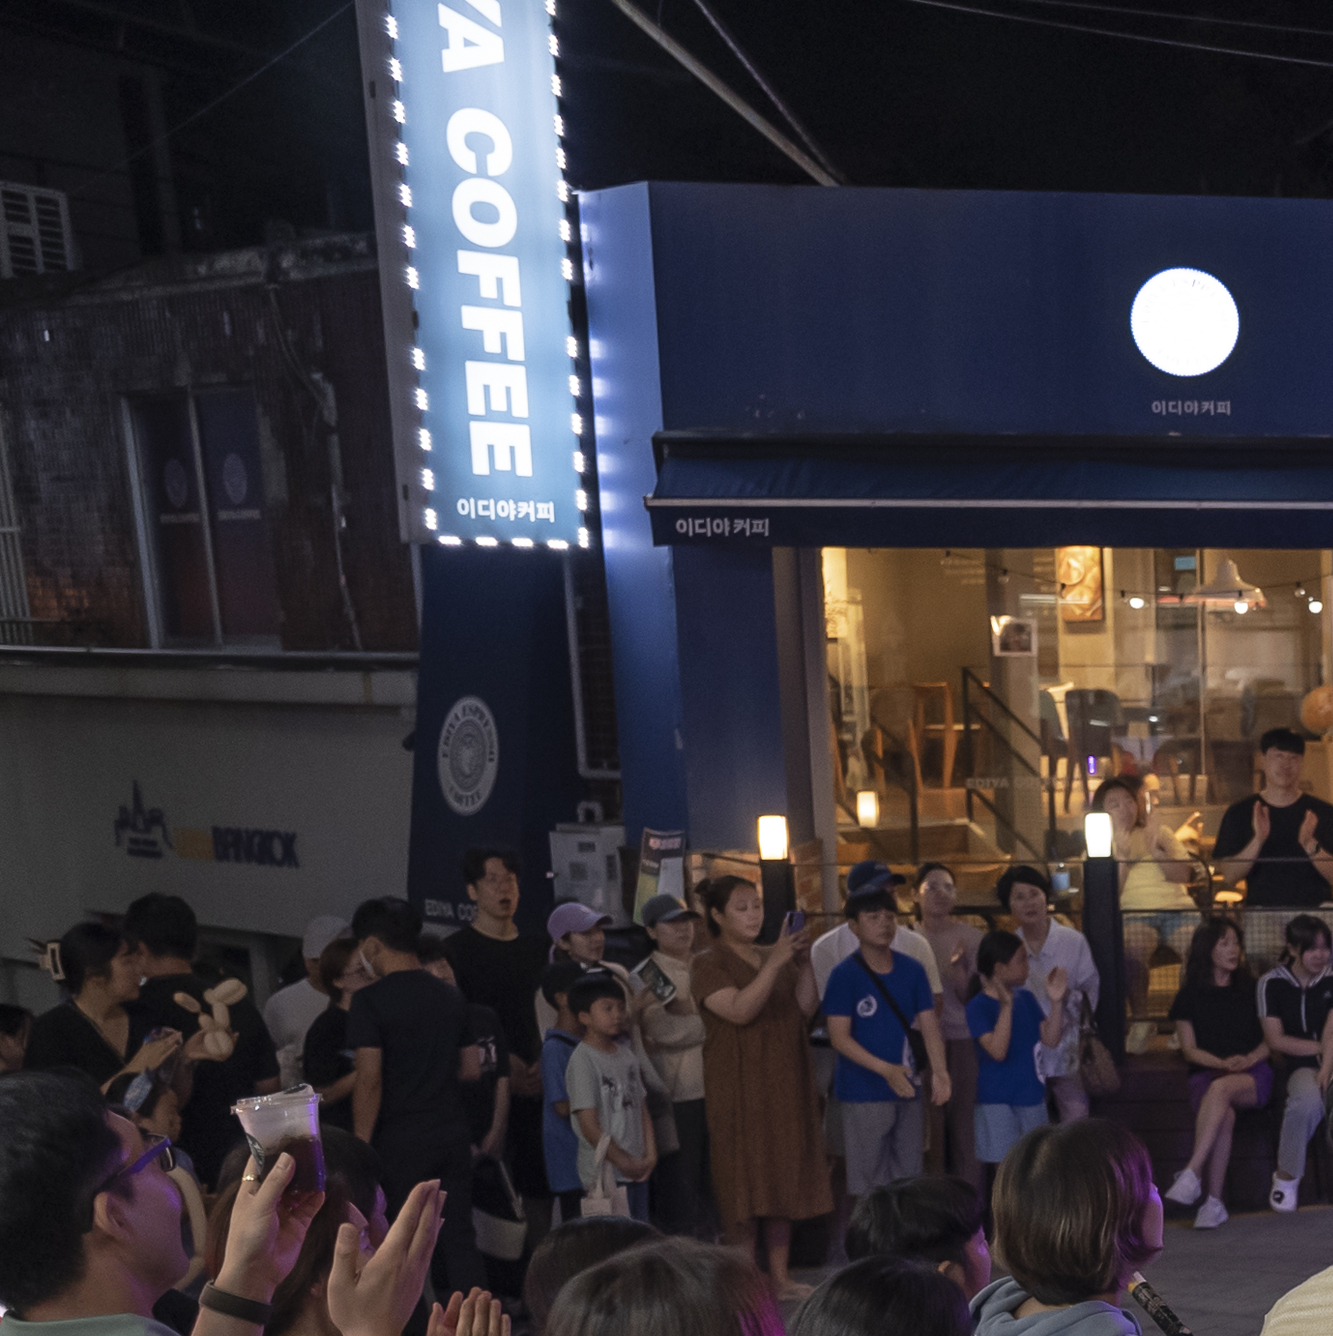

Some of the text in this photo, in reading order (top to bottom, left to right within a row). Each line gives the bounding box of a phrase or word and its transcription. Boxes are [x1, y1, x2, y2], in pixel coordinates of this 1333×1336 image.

[446, 107, 533, 478] COFFEE
[1151, 400, 1231, 416] 이디야커피
[456, 497, 555, 523] 이디야커피
